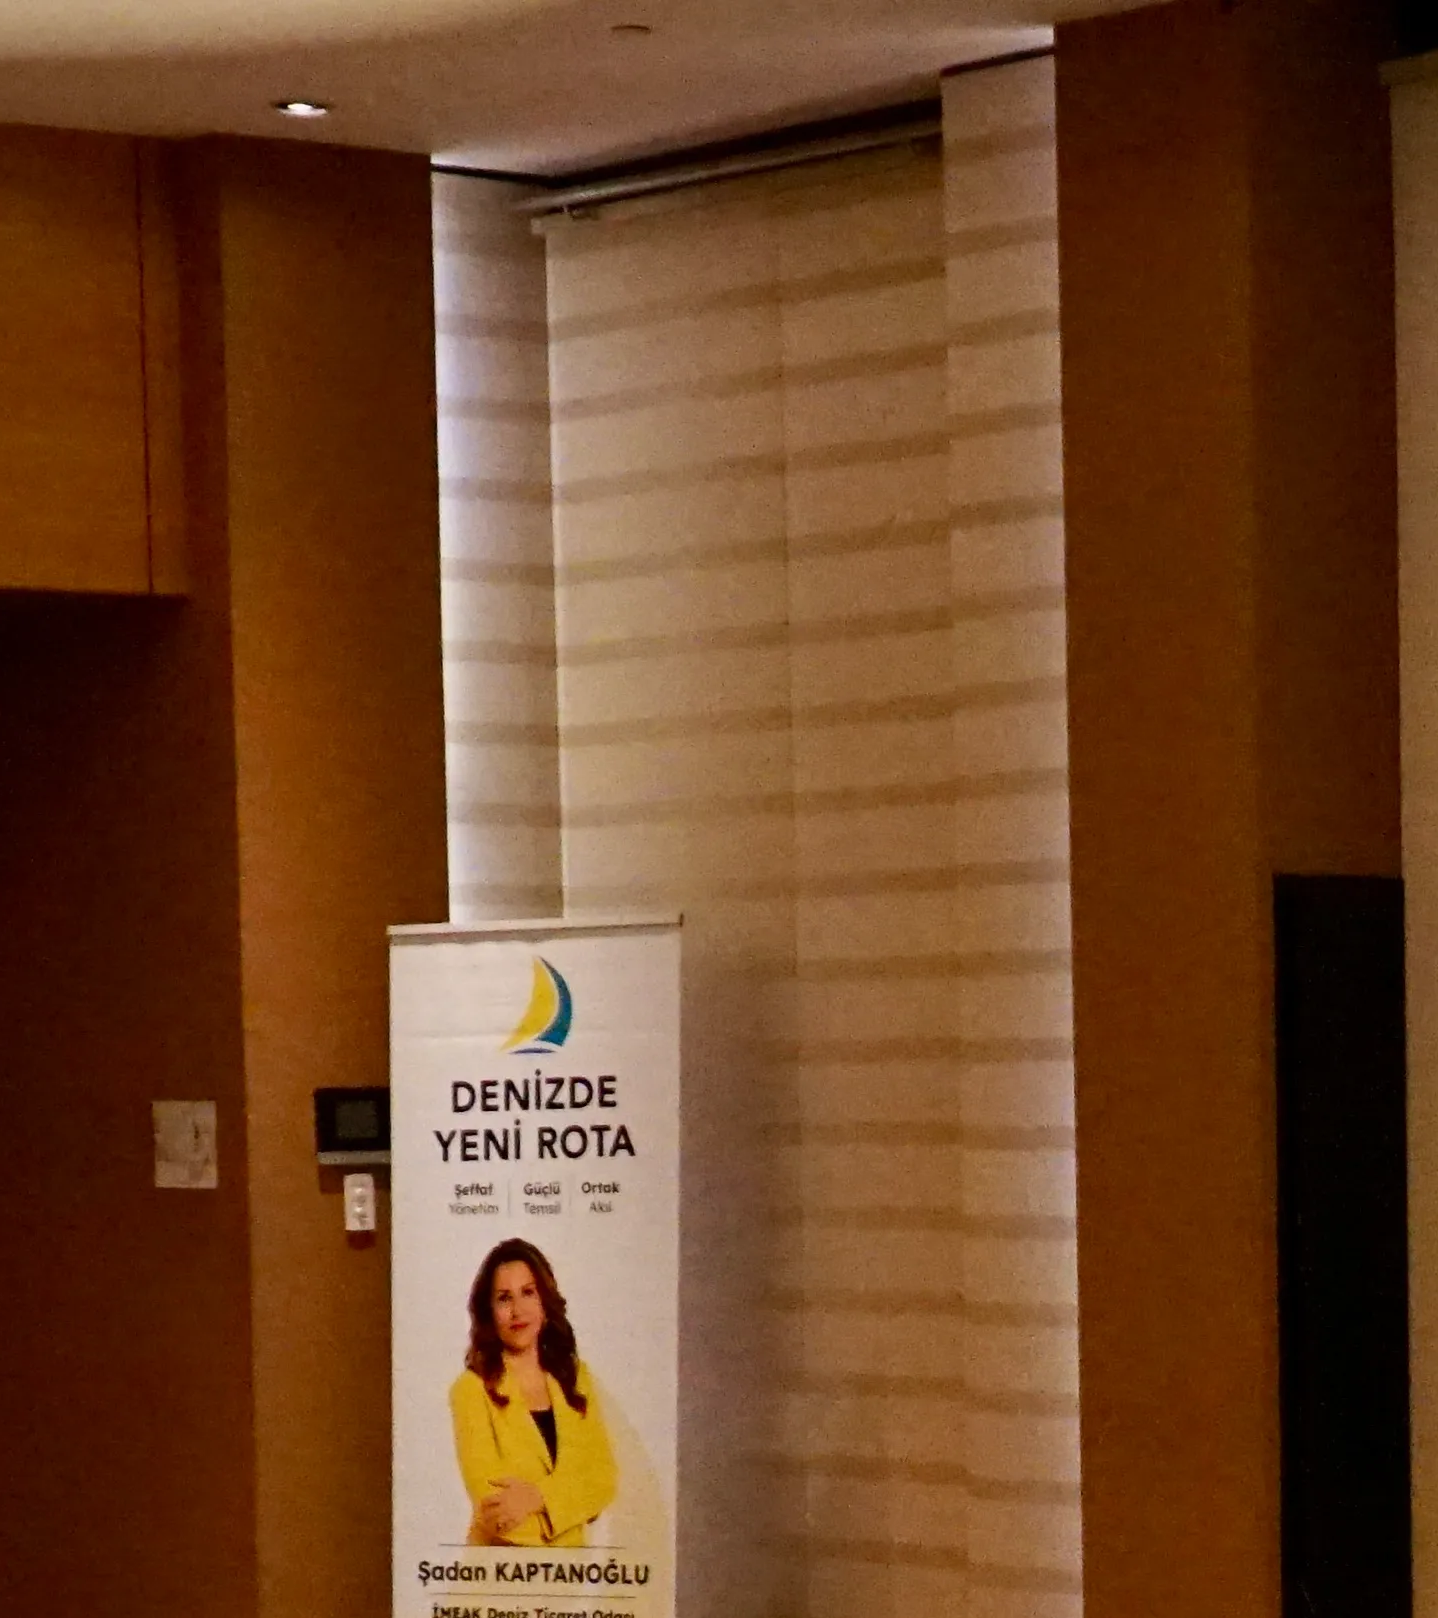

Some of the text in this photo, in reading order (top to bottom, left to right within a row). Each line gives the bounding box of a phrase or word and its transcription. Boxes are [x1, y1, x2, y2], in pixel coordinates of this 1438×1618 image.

[451, 1069, 618, 1113] DENİZDE
[433, 1118, 636, 1163] YENİ ROTA
[523, 1181, 561, 1198] Güçlü
[581, 1181, 620, 1194] Ortak
[418, 1558, 649, 1586] Şadan KAPTANOĞLU
